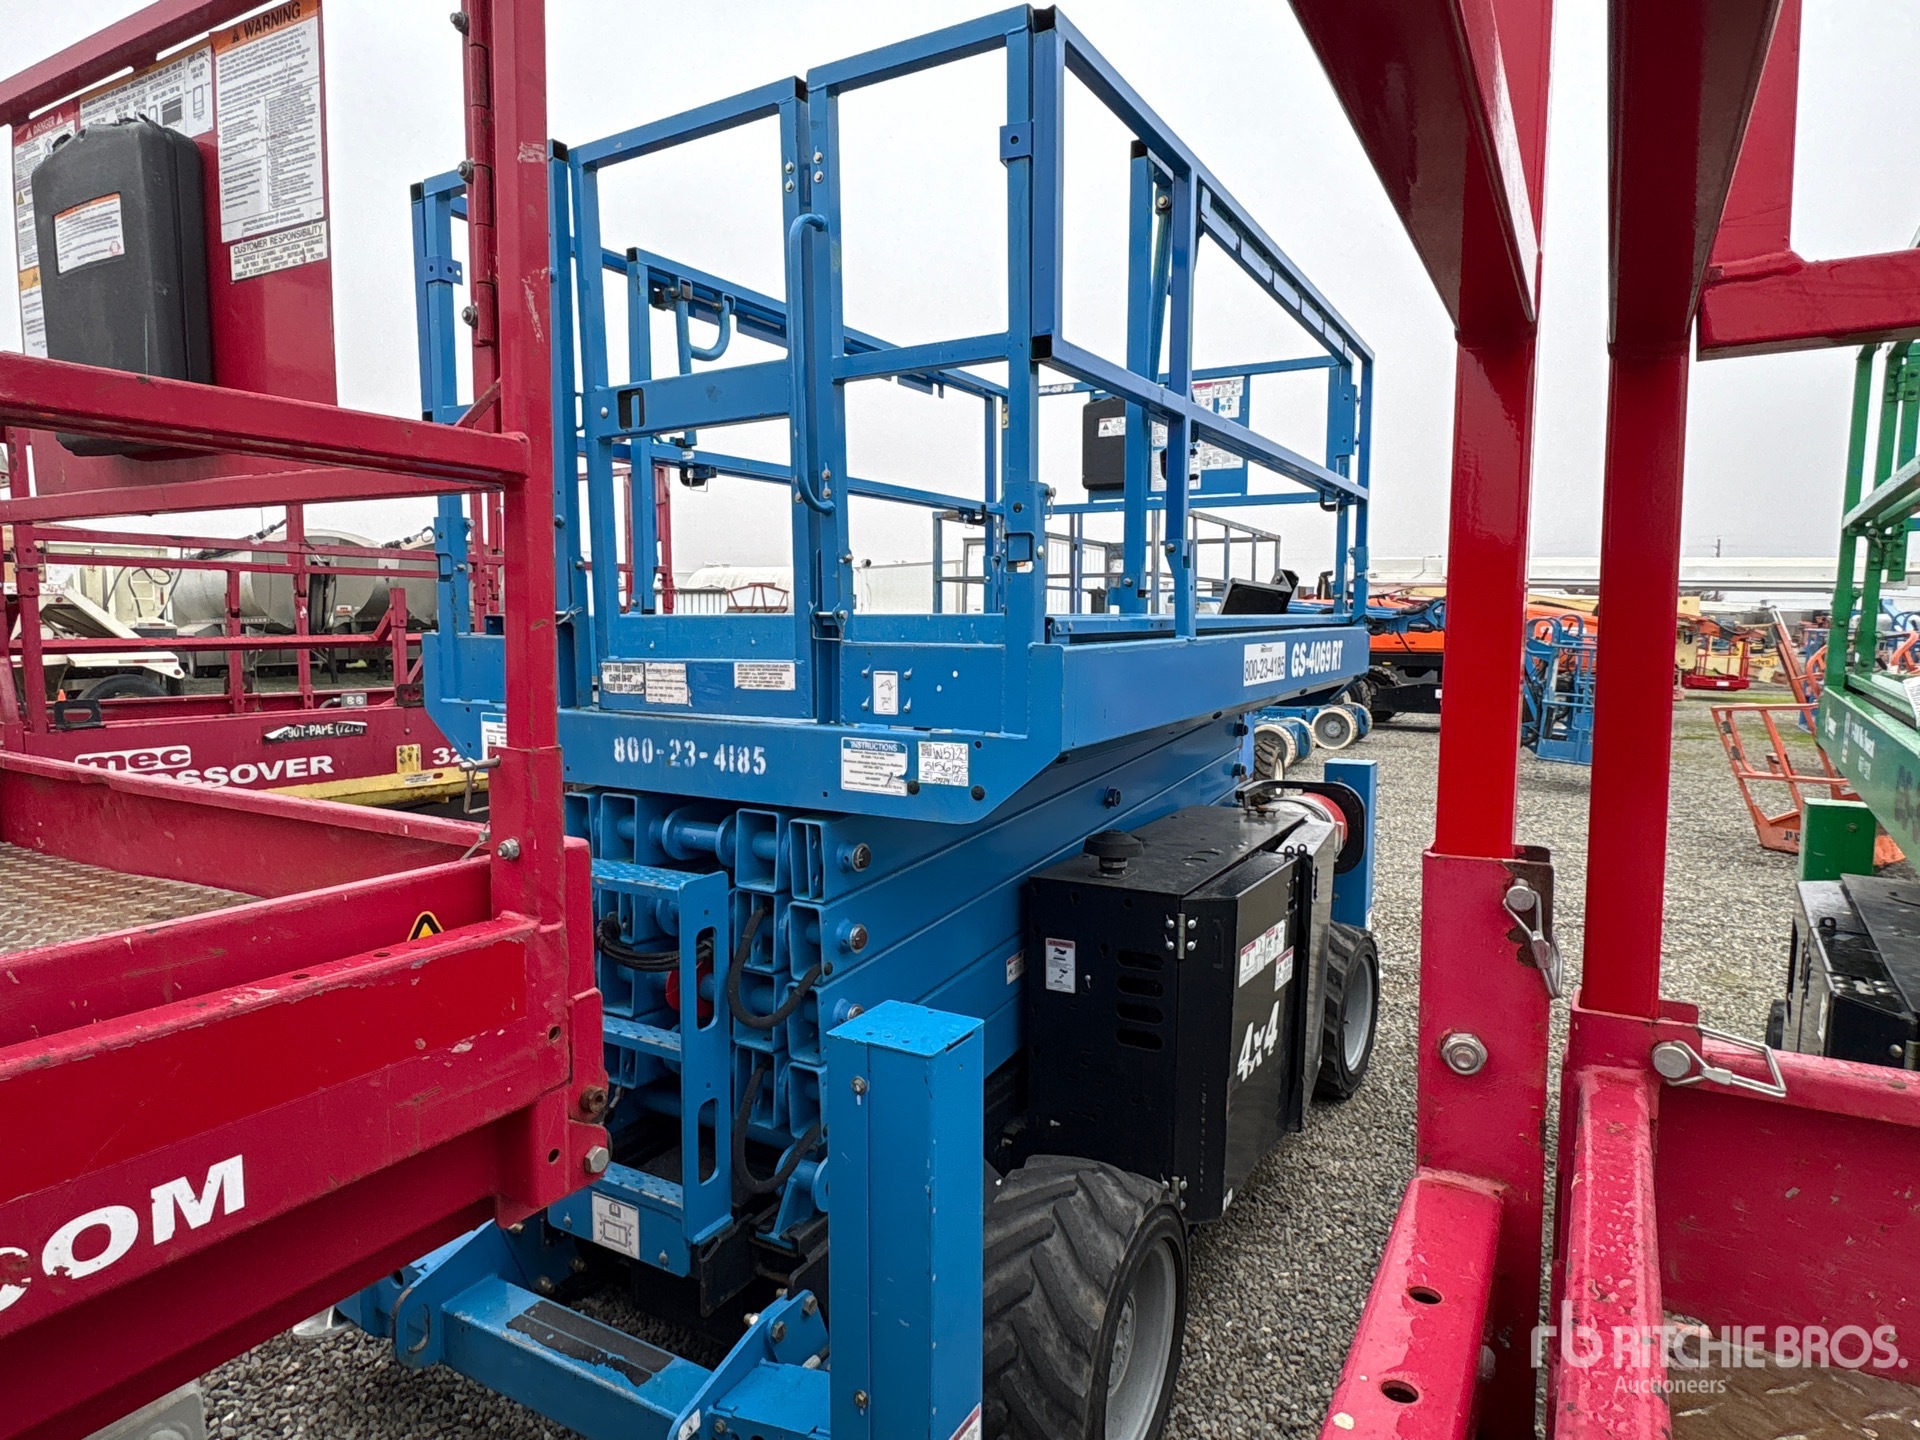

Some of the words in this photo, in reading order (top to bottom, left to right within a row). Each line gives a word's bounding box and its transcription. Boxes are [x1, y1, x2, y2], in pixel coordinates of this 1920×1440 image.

[244, 1, 301, 39] WARNING
[234, 238, 268, 255] CUSTOMER
[270, 223, 323, 246] RESPONSIBILITY
[614, 736, 767, 776] 800-23-4185
[850, 740, 898, 752] INSTRUCTIONS
